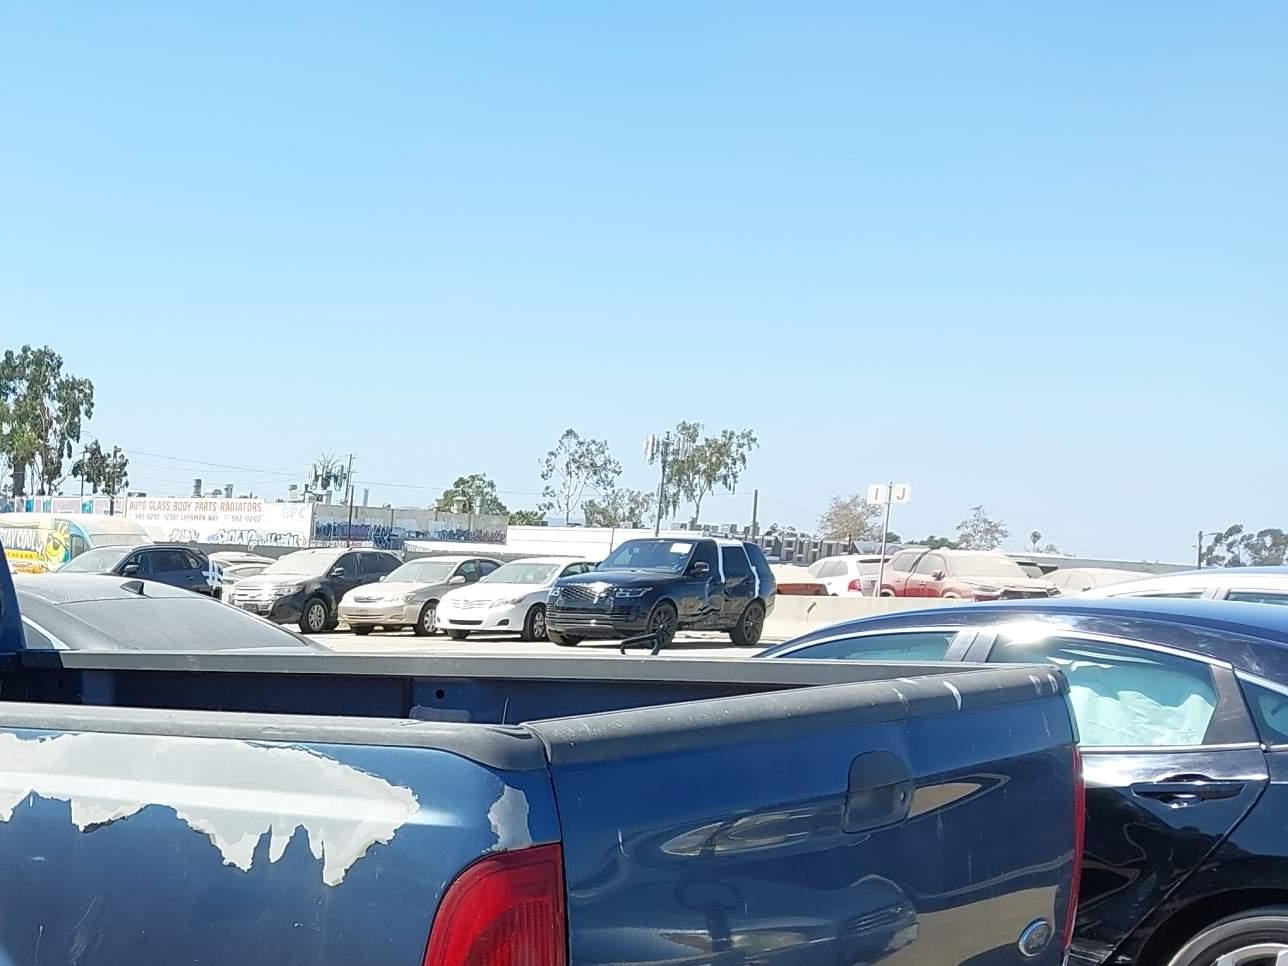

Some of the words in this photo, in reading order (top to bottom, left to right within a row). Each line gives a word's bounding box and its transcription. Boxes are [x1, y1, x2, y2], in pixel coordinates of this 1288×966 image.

[896, 487, 906, 501] J
[129, 501, 147, 511] AUTO
[149, 501, 171, 511] GLASS
[173, 501, 192, 512] BODY
[195, 502, 217, 512] PARTS
[220, 502, 263, 513] RADIATORS
[16, 528, 37, 551] COOL
